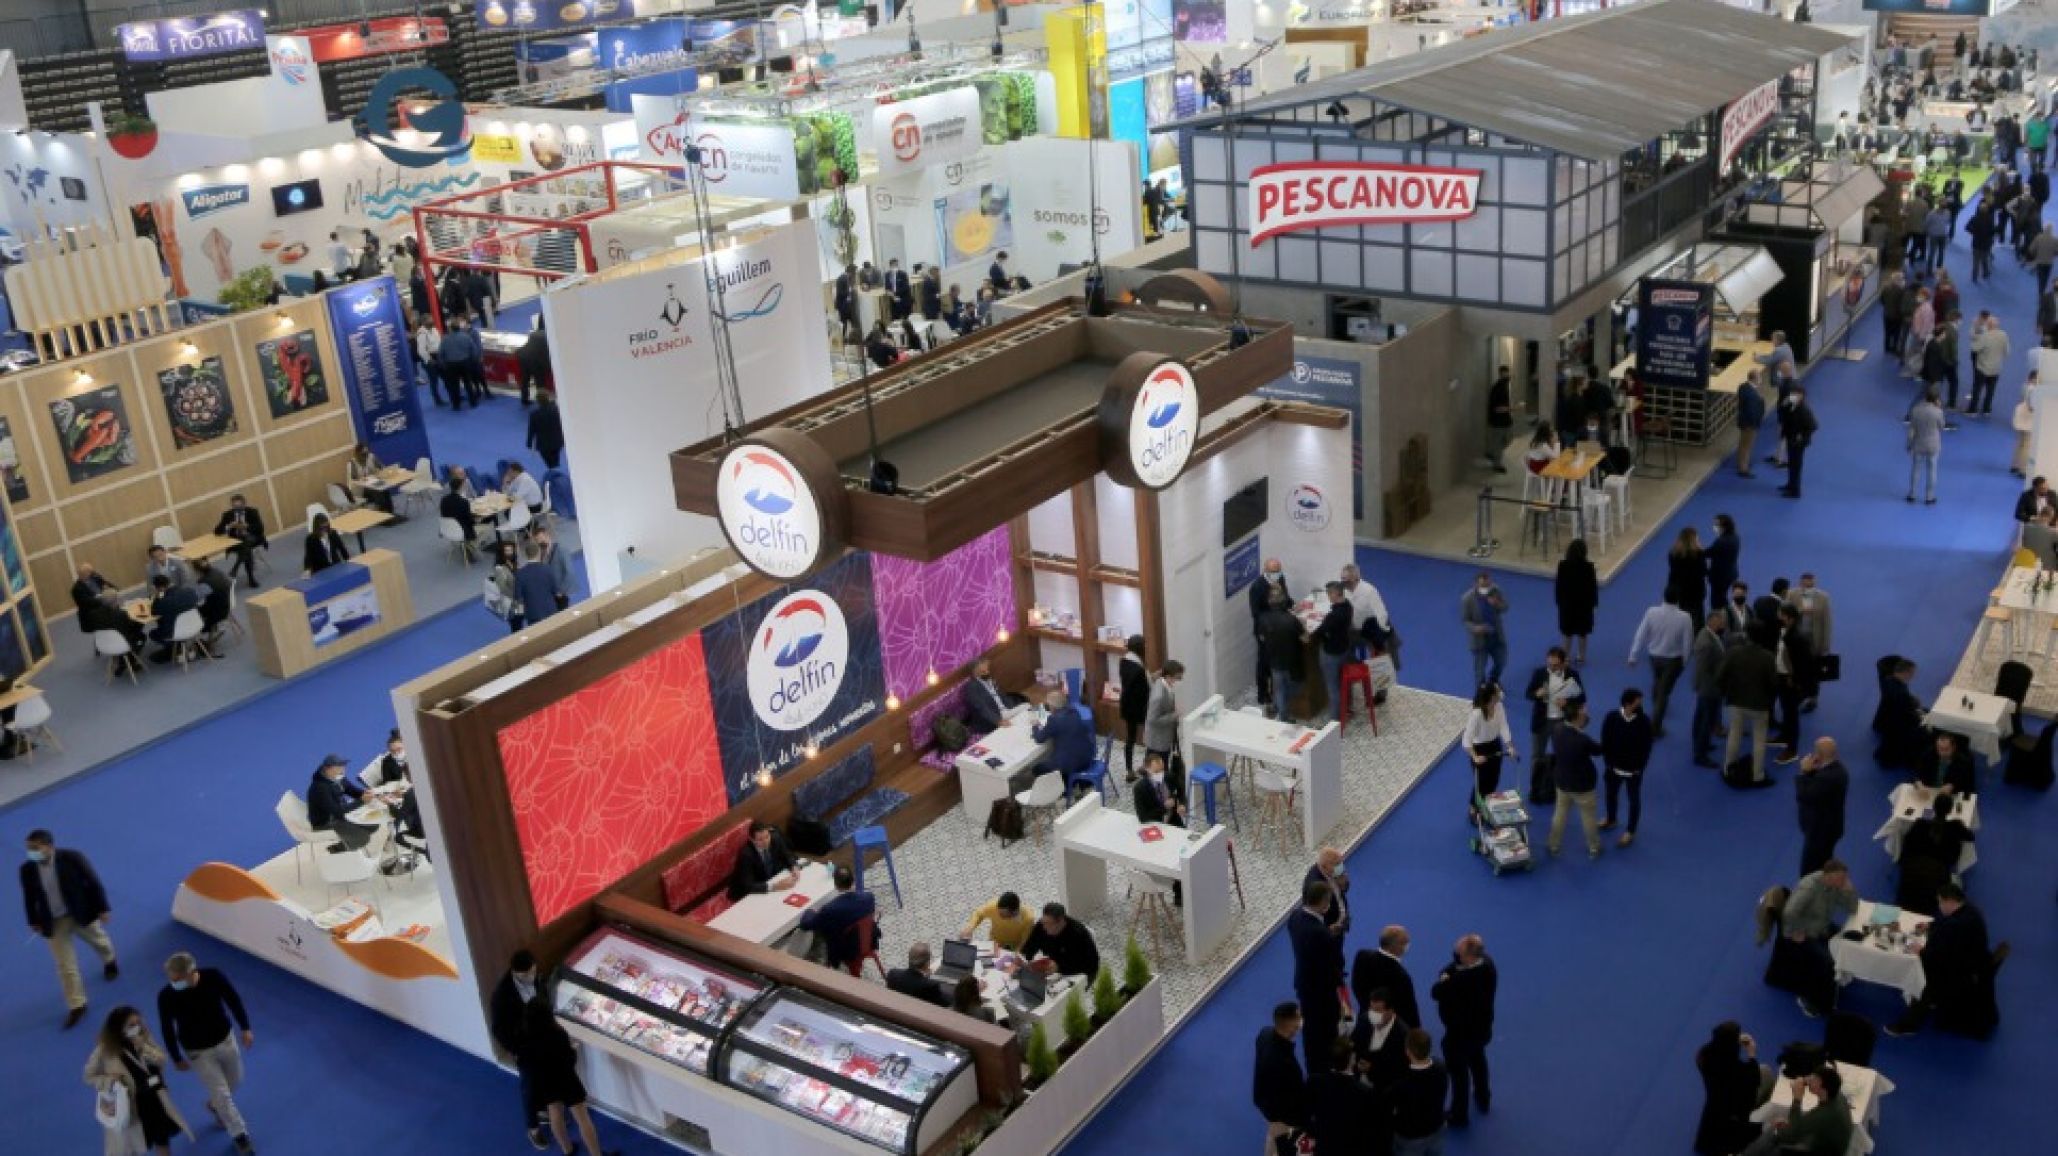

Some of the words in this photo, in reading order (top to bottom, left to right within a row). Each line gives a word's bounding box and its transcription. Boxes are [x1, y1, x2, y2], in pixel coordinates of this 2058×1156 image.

[168, 28, 258, 53] FIORITAL
[190, 189, 243, 210] Aligator
[1258, 175, 1470, 223] PESCANOVA
[1033, 208, 1088, 226] somos
[631, 335, 693, 358] VALENCIA
